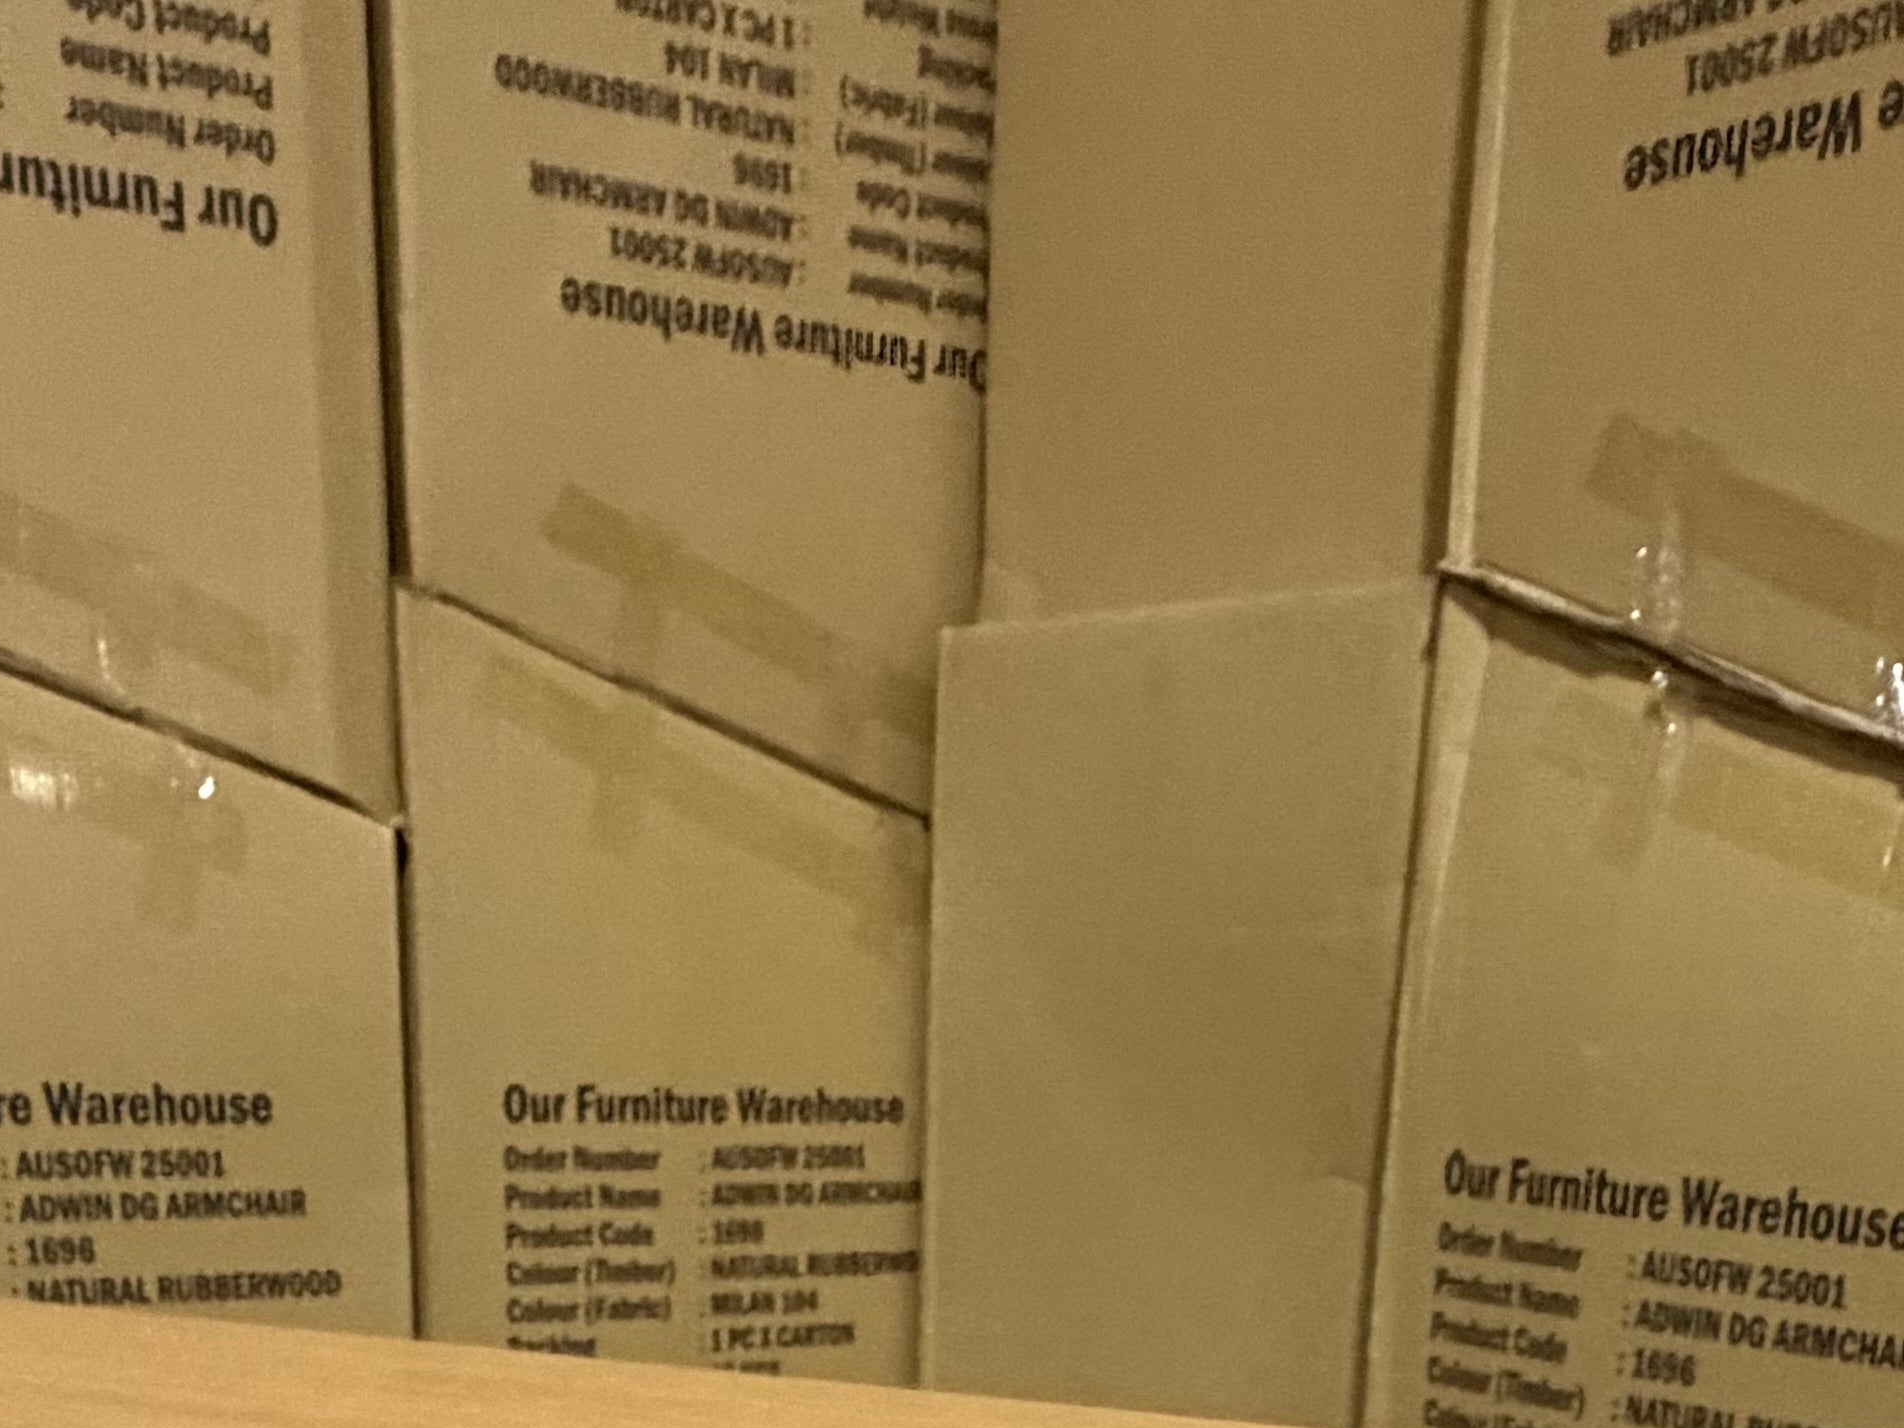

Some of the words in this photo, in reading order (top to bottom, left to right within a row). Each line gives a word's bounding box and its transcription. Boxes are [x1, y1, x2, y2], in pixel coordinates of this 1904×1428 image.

[154, 0, 270, 57] Product
[60, 36, 149, 86] Name
[158, 54, 272, 110] Product
[65, 97, 186, 149] Number
[194, 119, 274, 165] Order
[1623, 89, 1863, 191] Warehouse
[197, 185, 278, 247] Our
[560, 277, 766, 357] Warehouse
[773, 313, 928, 383] Furniture
[41, 1081, 273, 1126] Warehouse
[503, 1083, 566, 1123] Our
[576, 1083, 728, 1124] Furniture
[736, 1085, 904, 1124] Warehouse
[16, 1151, 135, 1180] AUSOFW
[141, 1150, 225, 1179] 25001
[1445, 1148, 1500, 1198] Our
[1508, 1157, 1670, 1222] Furniture
[20, 1193, 113, 1223] ADWIN
[120, 1192, 160, 1220] DG
[166, 1188, 307, 1219] ARMCHAIR
[26, 1276, 152, 1305] NATURAL
[157, 1269, 342, 1303] RUBBERWOOD
[1757, 1264, 1847, 1310] 25001
[1729, 1311, 1768, 1349] DG
